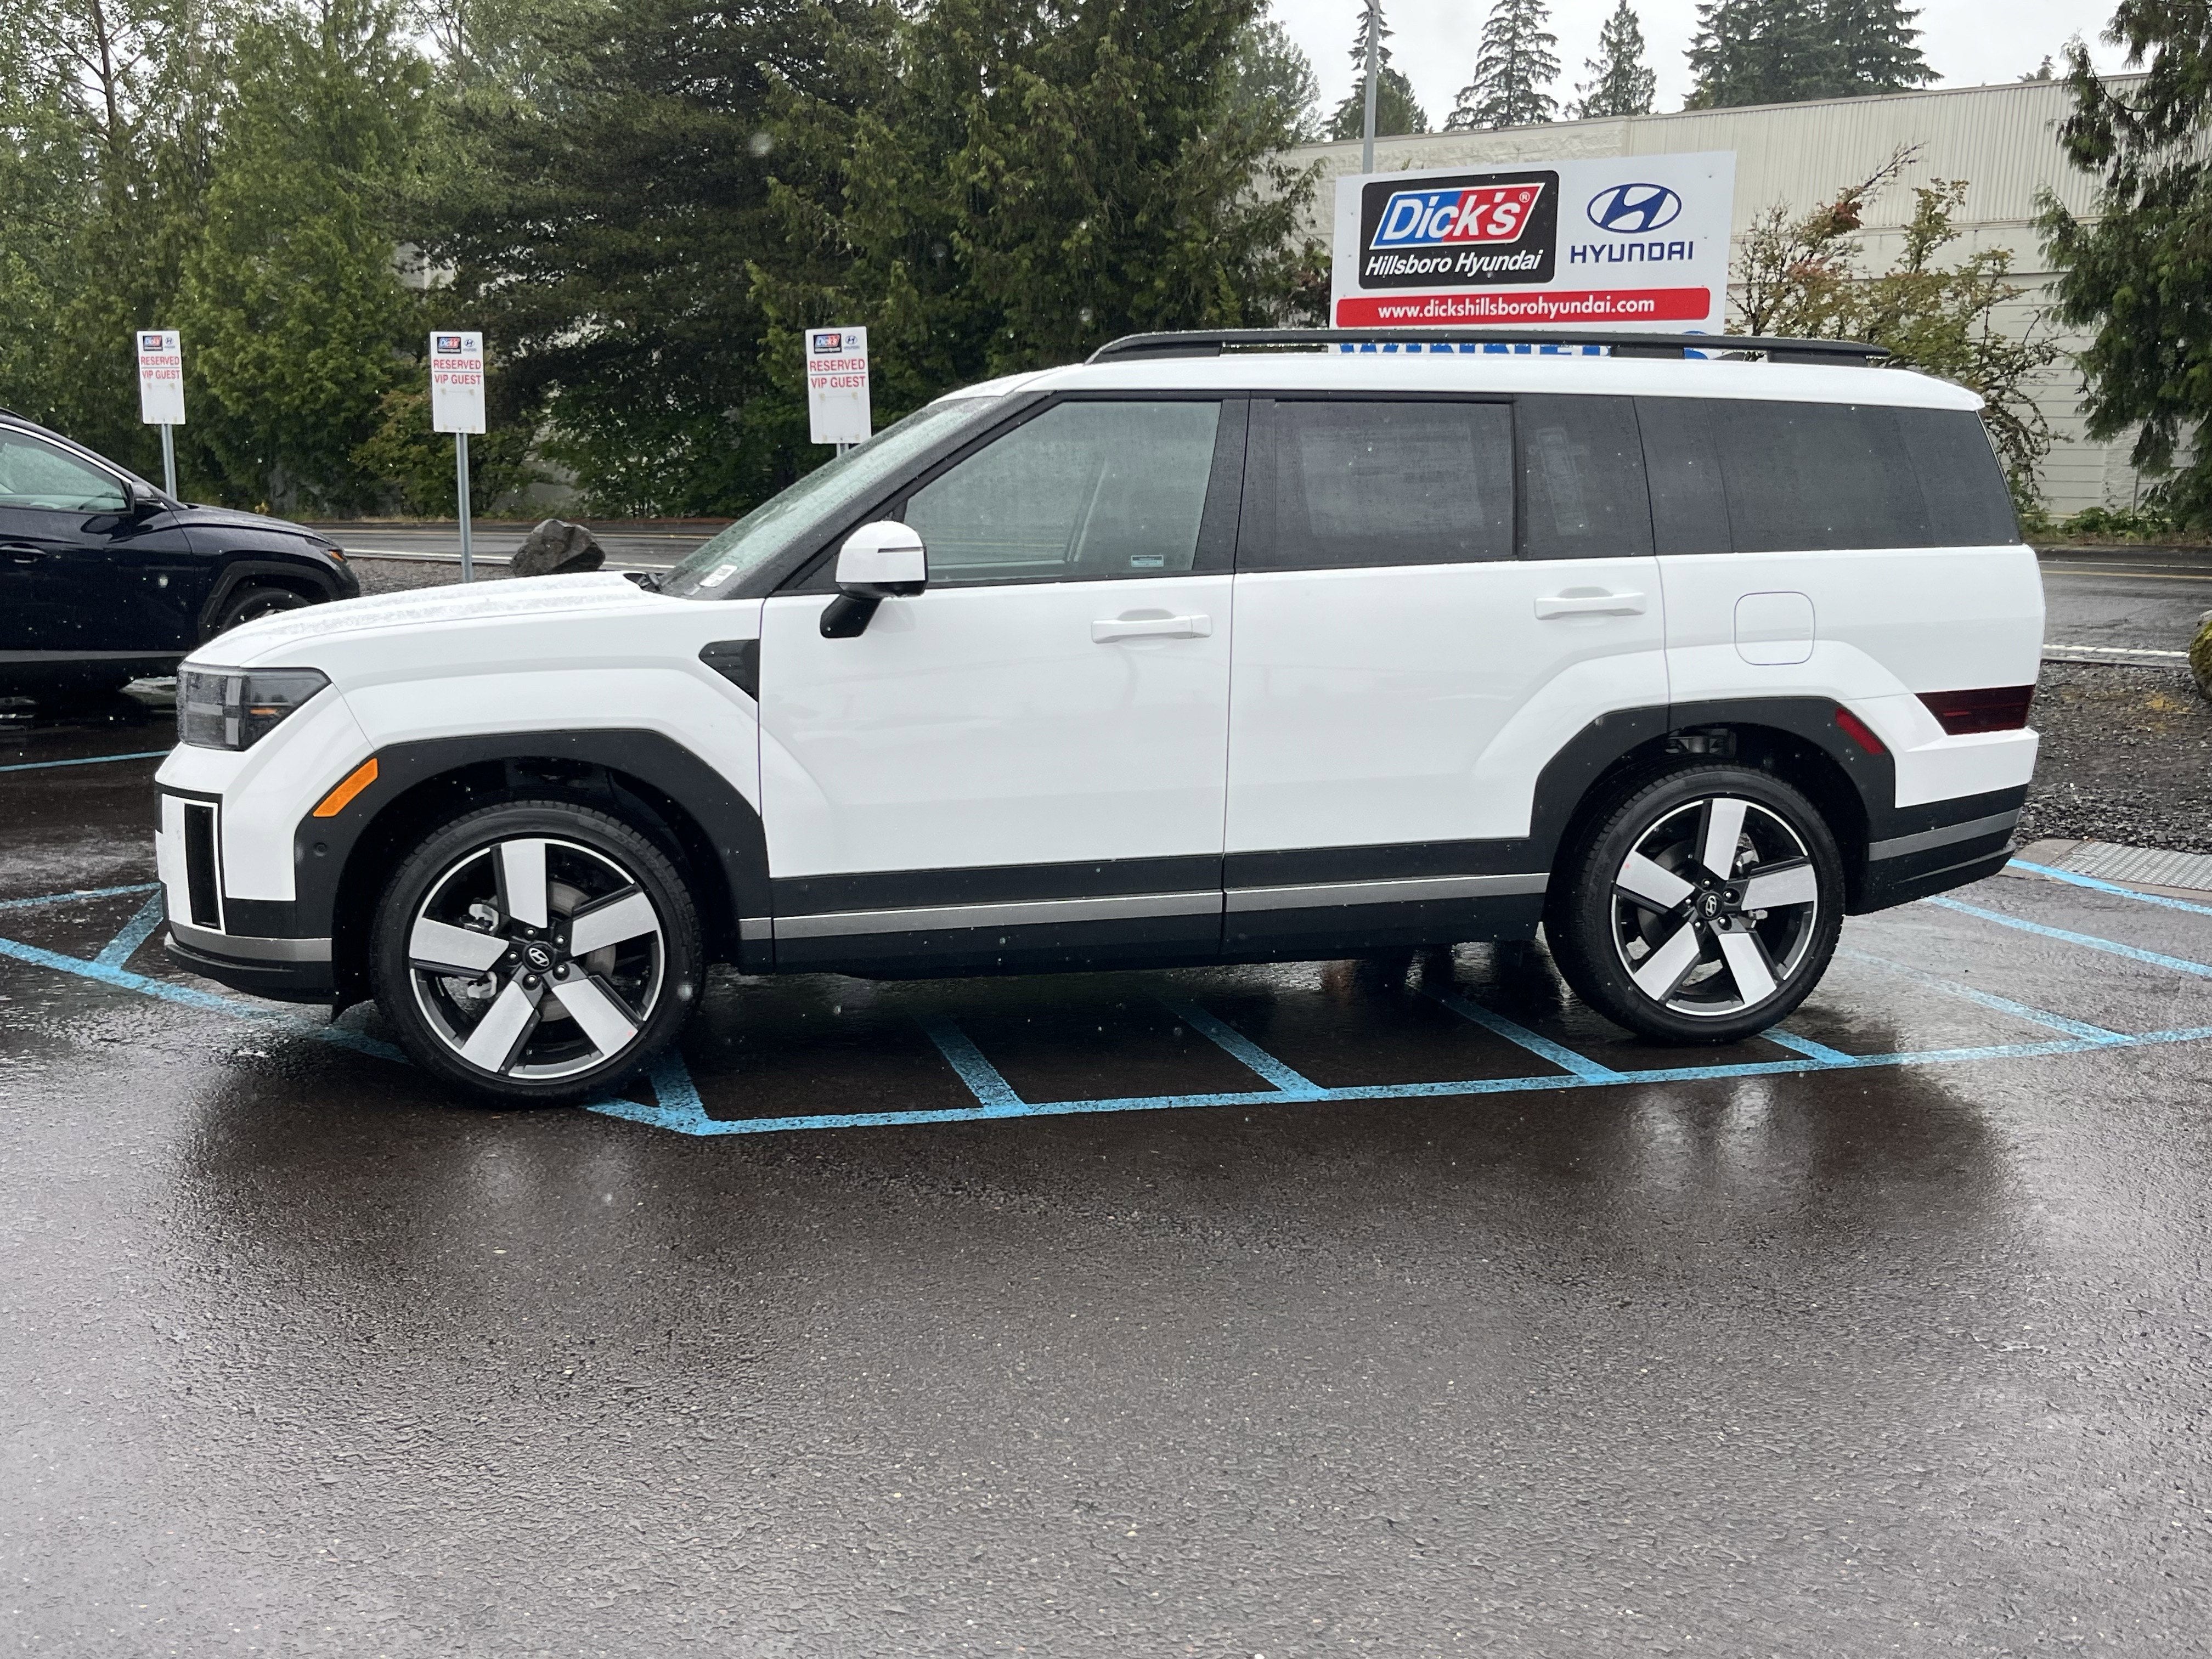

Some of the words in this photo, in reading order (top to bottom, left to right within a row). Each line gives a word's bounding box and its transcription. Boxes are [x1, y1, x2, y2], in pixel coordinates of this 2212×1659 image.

[1383, 191, 1521, 240] Dick's
[1570, 240, 1694, 264] HYUNDAI
[1365, 253, 1453, 276] Hillsboro
[1454, 249, 1544, 277] Hyundai
[1378, 294, 1655, 319] www.dickshillsborohyundai.com
[140, 356, 179, 365] RESERVED
[433, 359, 481, 369] RESERVED
[809, 359, 865, 372] RESERVED
[142, 370, 153, 379] VIP
[155, 370, 180, 379] GUEST
[435, 374, 448, 384] VIP
[451, 374, 482, 385] GUEST
[811, 377, 827, 388] VIP
[830, 376, 866, 388] GUEST
